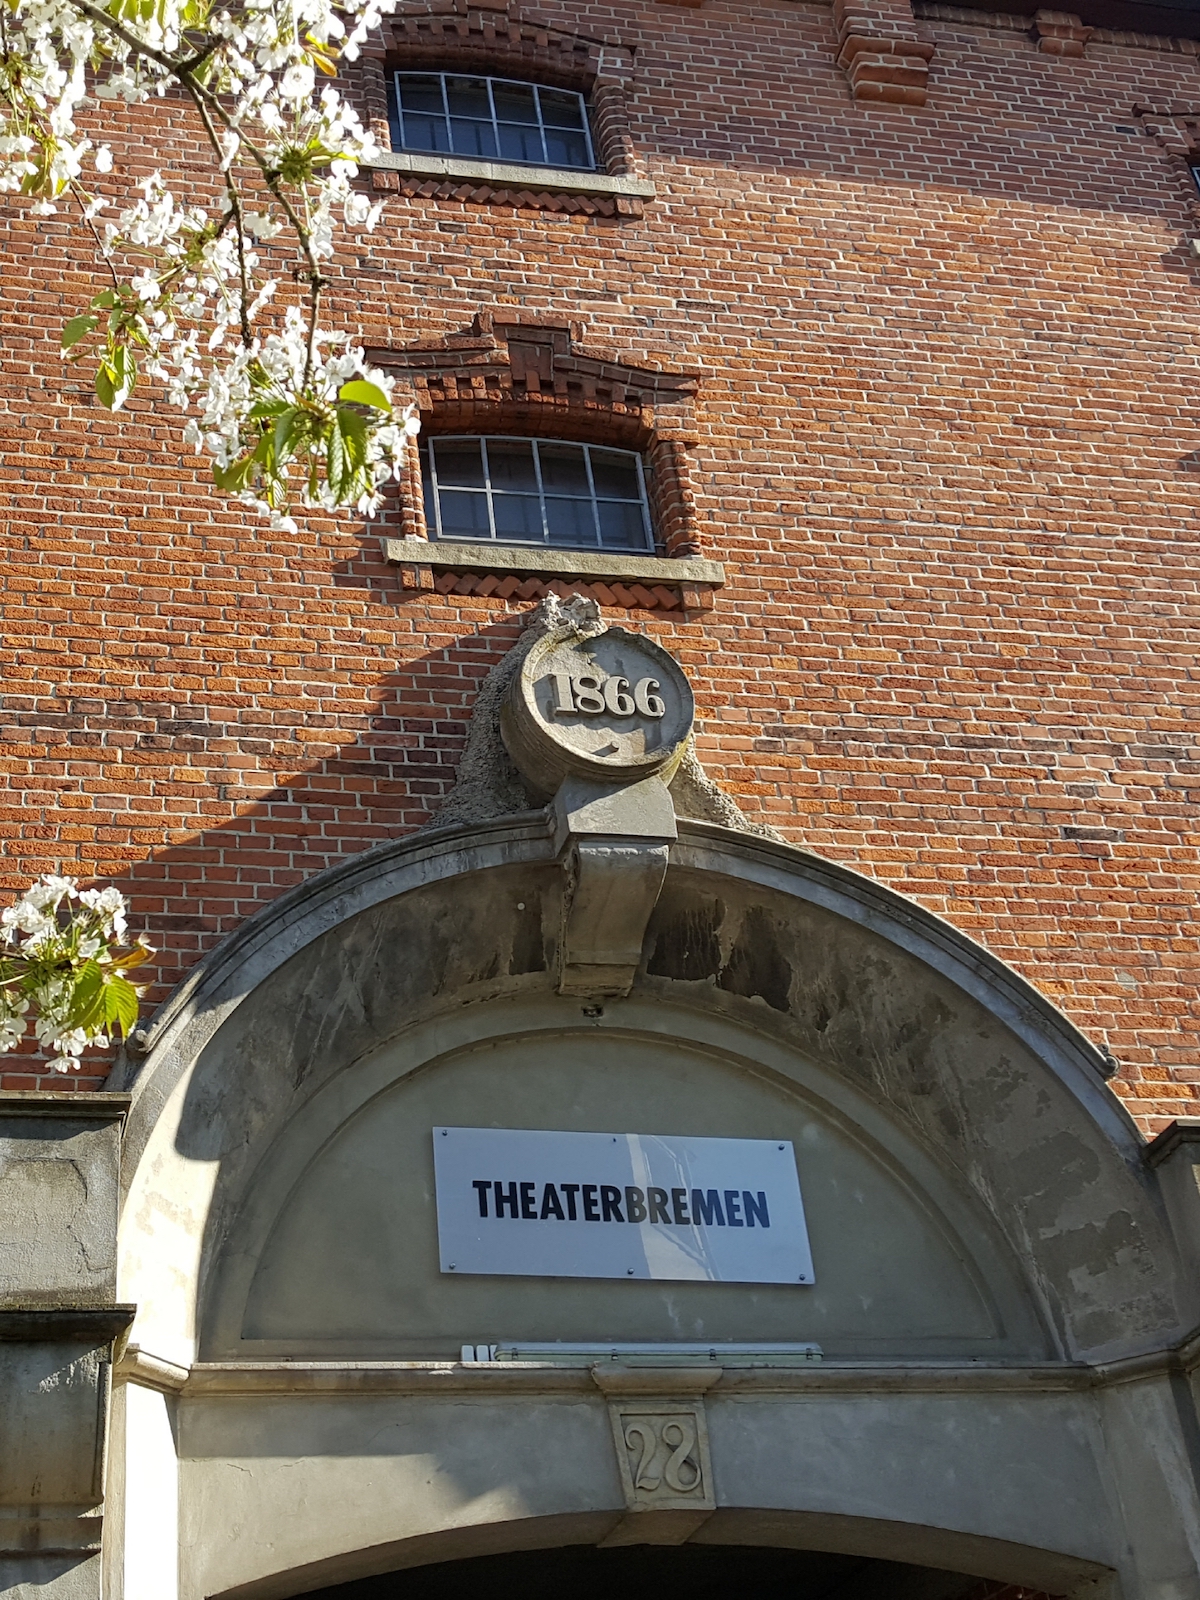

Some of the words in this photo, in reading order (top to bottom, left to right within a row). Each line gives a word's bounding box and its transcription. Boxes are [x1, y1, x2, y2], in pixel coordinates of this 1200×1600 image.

[549, 674, 666, 718] 1866
[472, 1180, 770, 1228] THEATERBREMEN
[625, 1422, 701, 1491] 28
